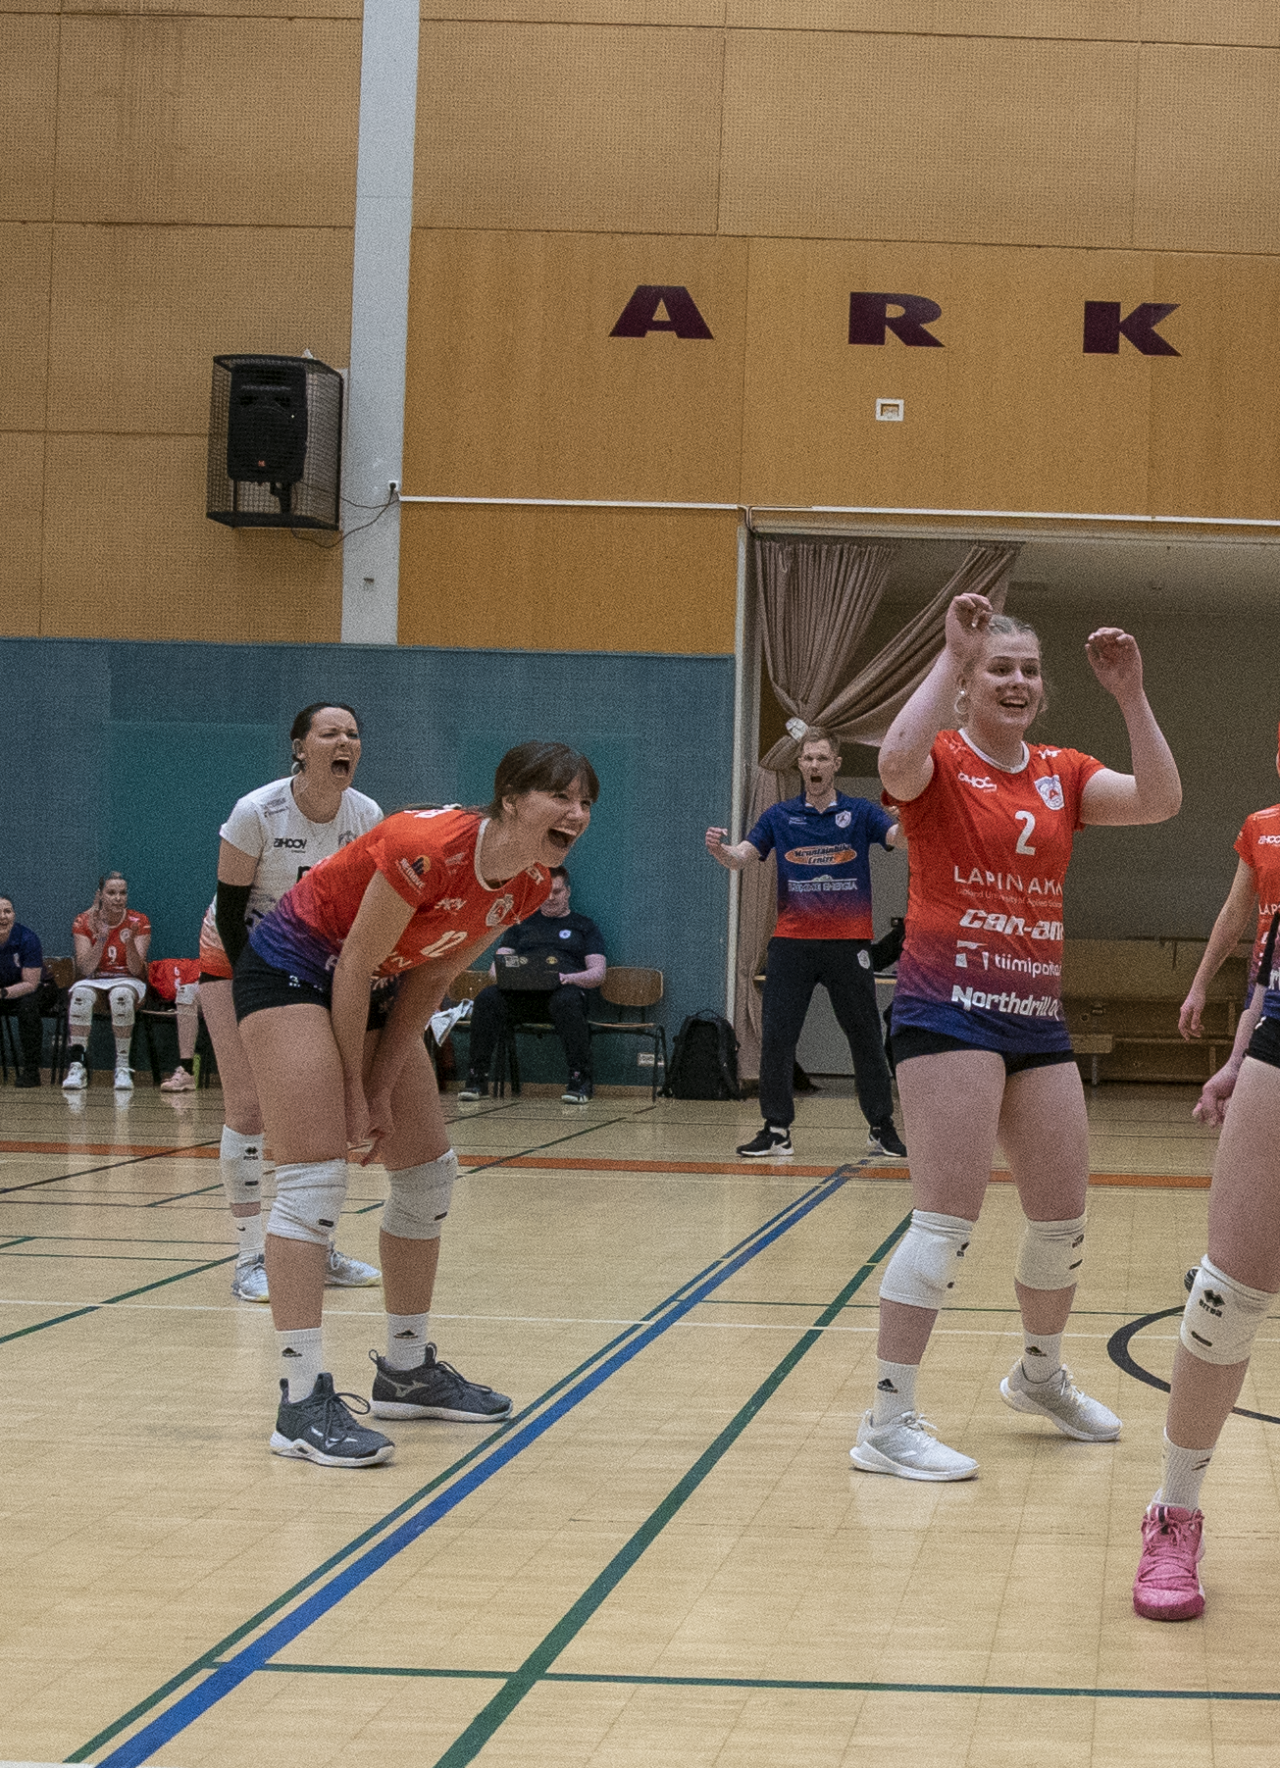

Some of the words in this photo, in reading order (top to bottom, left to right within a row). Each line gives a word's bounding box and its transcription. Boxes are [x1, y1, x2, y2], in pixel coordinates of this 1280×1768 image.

[1014, 810, 1036, 856] 2
[954, 865, 1024, 892] LAPIN
[420, 930, 468, 958] 12
